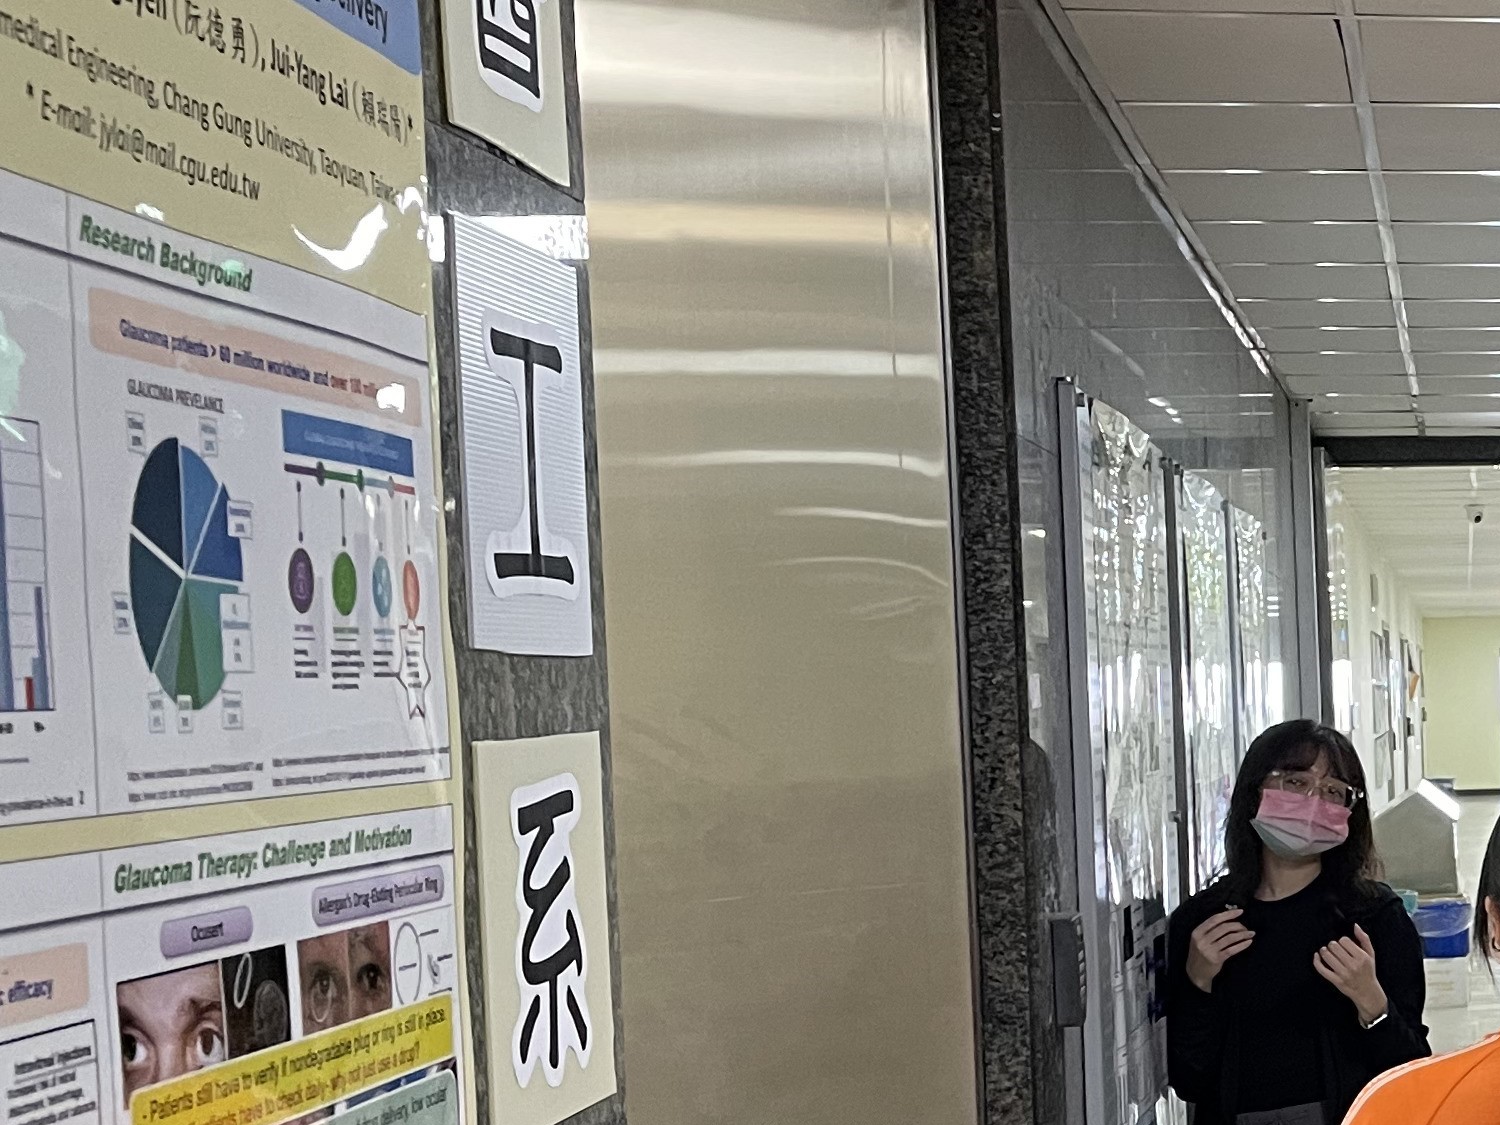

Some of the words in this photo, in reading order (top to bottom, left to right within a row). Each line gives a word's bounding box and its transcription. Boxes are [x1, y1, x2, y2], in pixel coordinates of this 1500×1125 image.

[163, 81, 210, 132] Chang
[213, 102, 253, 149] Gung
[328, 71, 350, 110] Lai
[79, 214, 156, 264] Research
[158, 242, 253, 293] Background
[113, 854, 192, 895] Glaucoma
[197, 849, 258, 880] Therapy:
[262, 839, 326, 869] Challenge
[329, 832, 352, 858] and
[354, 824, 412, 853] Motivation
